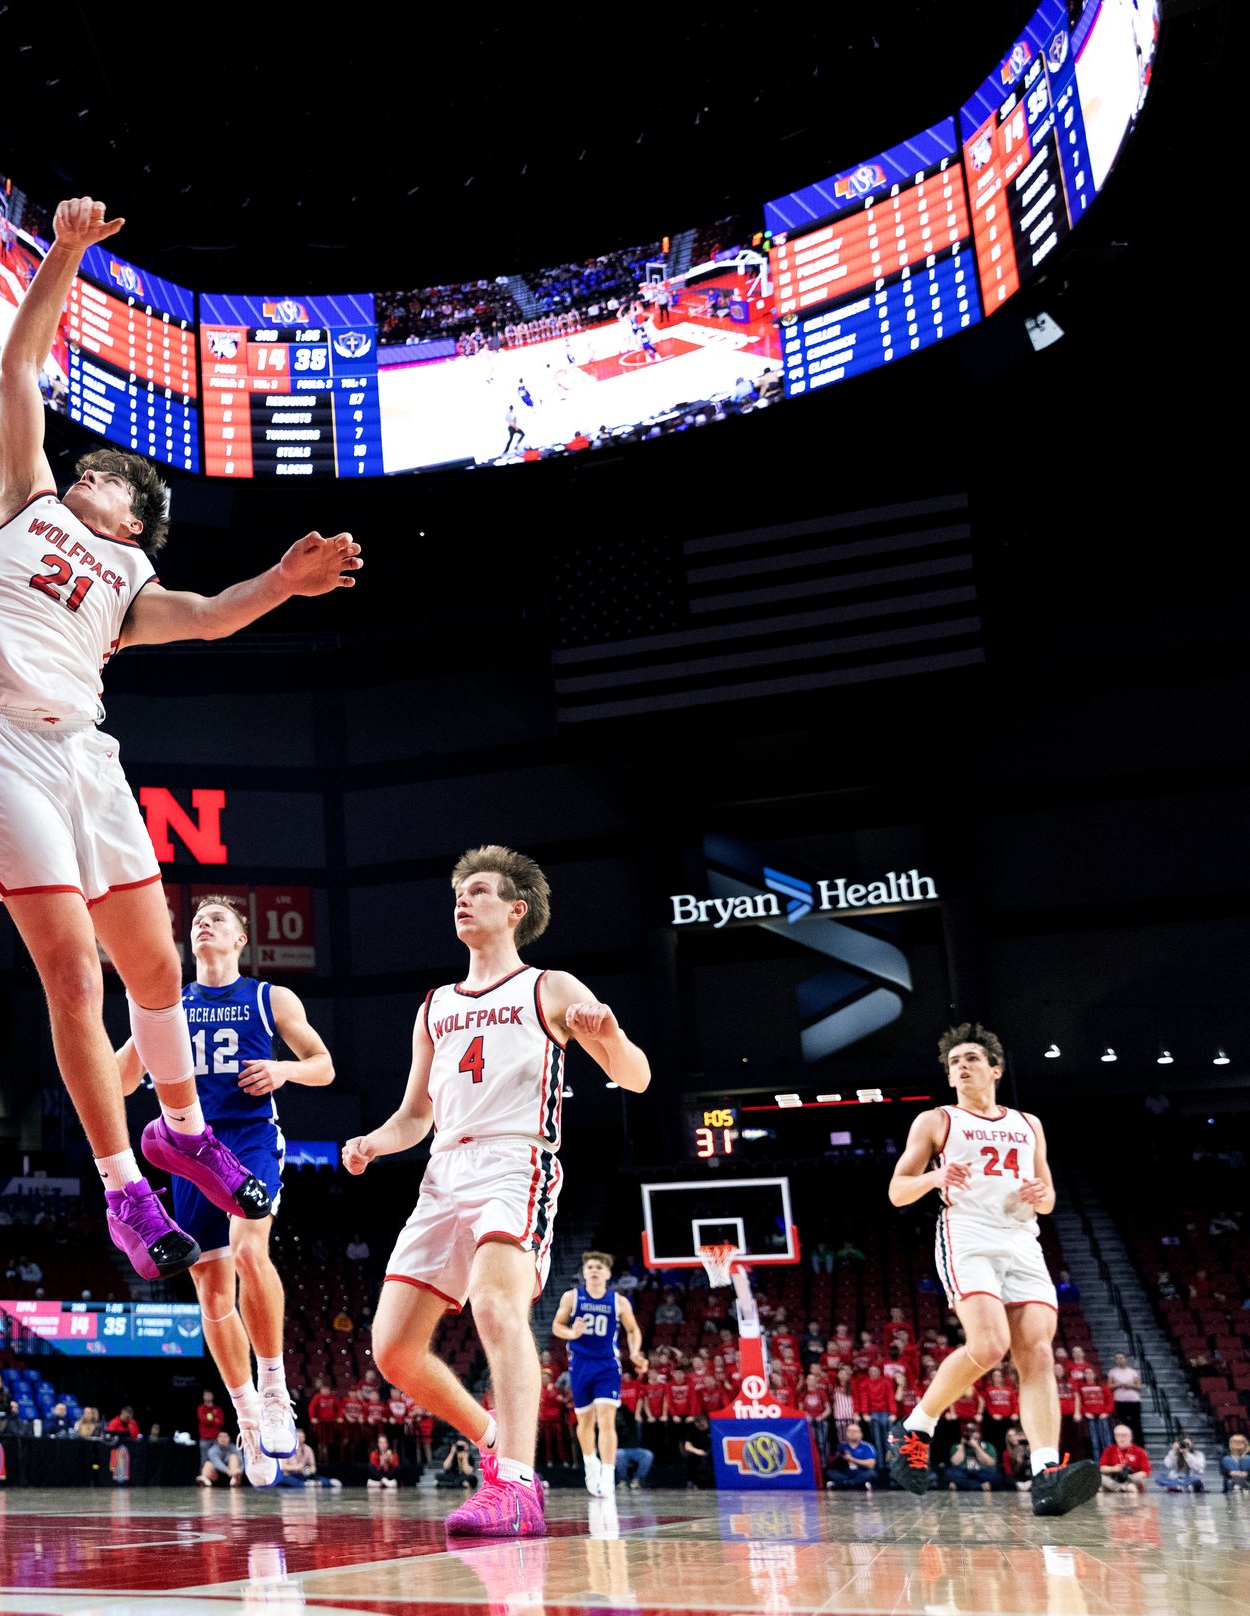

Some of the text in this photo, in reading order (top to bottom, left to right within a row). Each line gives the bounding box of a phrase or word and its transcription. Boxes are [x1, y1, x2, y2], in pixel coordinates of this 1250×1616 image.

[257, 348, 327, 371] 14 35
[28, 518, 127, 597] WOLFPACK
[29, 553, 95, 613] 21
[139, 786, 228, 865] N
[669, 868, 940, 929] Bryan Health
[266, 909, 304, 941] 10
[433, 1006, 524, 1040] WOLFPACK
[191, 1028, 239, 1076] 12
[459, 1036, 485, 1084] 4
[695, 1127, 733, 1158] 31
[962, 1129, 1030, 1146] WOLFPACK
[980, 1146, 1020, 1179] 24
[70, 1316, 90, 1335] 14
[103, 1317, 128, 1336] 35
[581, 1312, 608, 1337] 20
